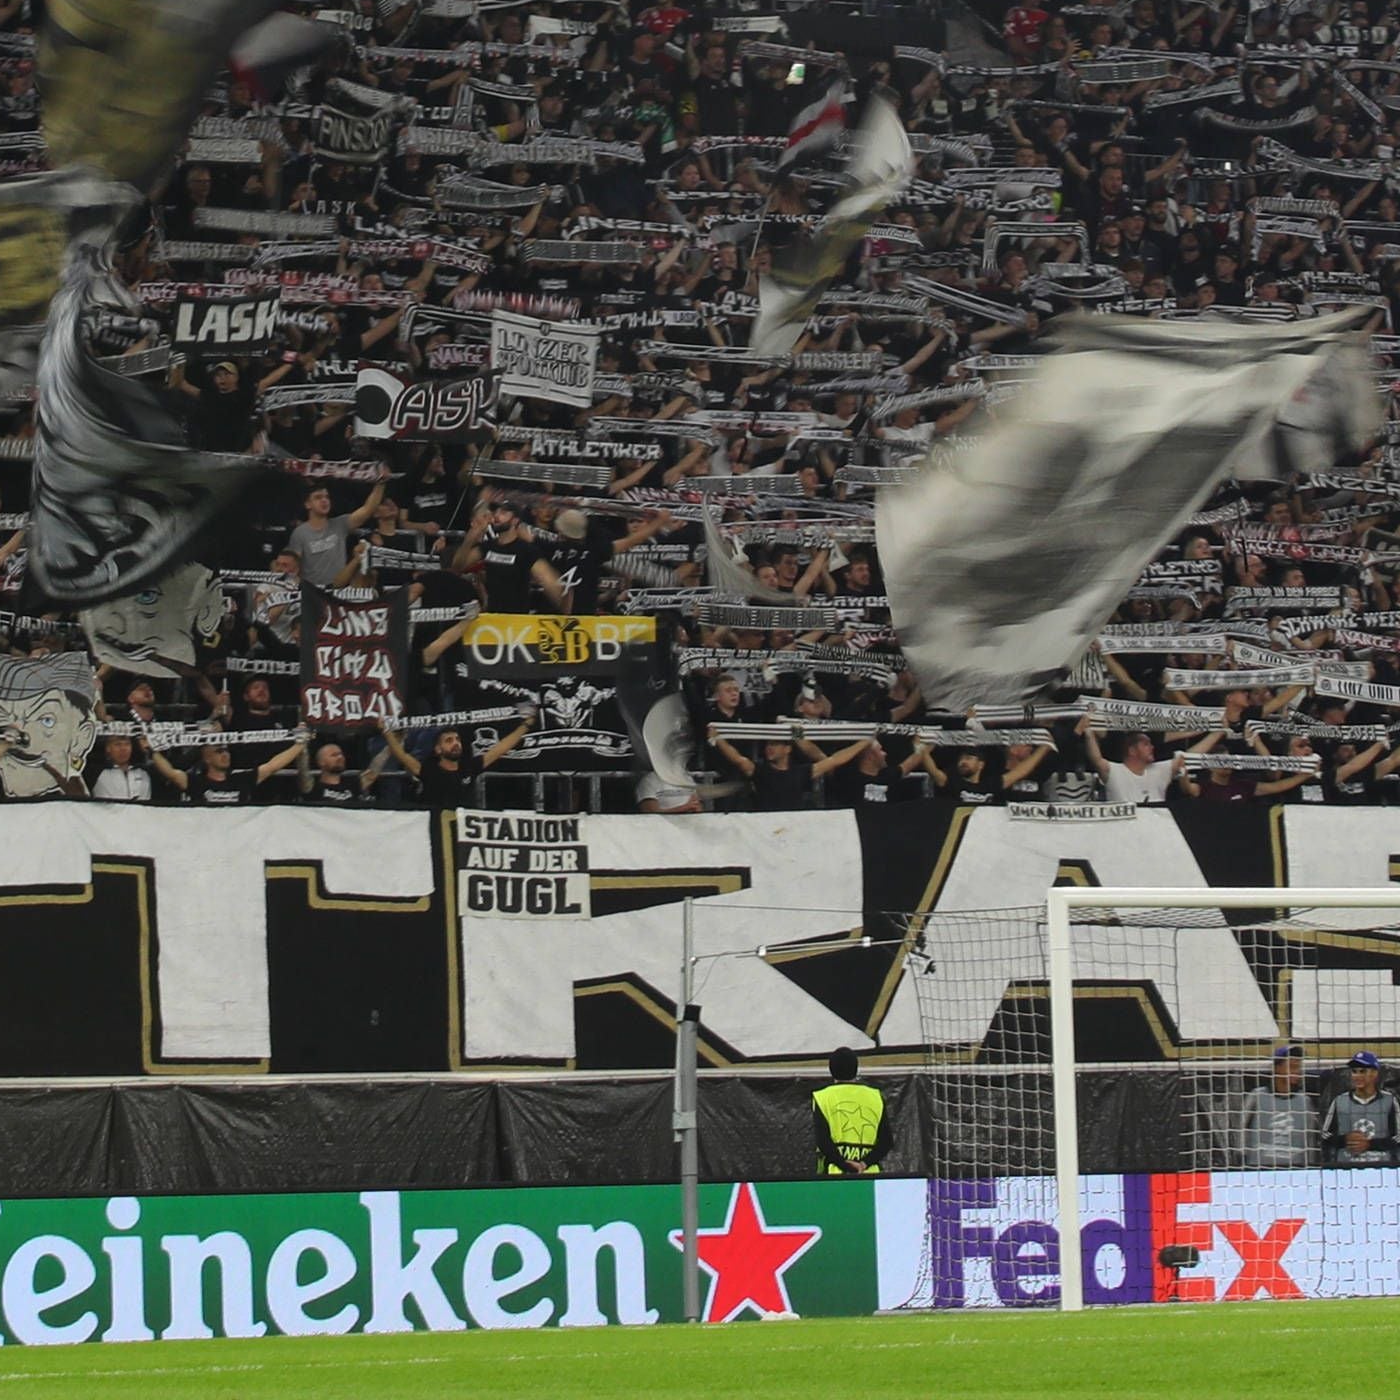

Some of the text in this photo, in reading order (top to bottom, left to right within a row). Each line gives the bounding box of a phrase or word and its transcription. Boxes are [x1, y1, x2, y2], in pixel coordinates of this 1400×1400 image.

[530, 438, 661, 460] ATHLETIKER
[471, 624, 535, 665] OK
[1338, 681, 1363, 697] LINZ
[1368, 683, 1393, 700] UND
[465, 814, 579, 843] STADION
[466, 847, 580, 872] AUF DER
[467, 874, 581, 915] GUGL
[933, 1173, 1306, 1308] FedEx
